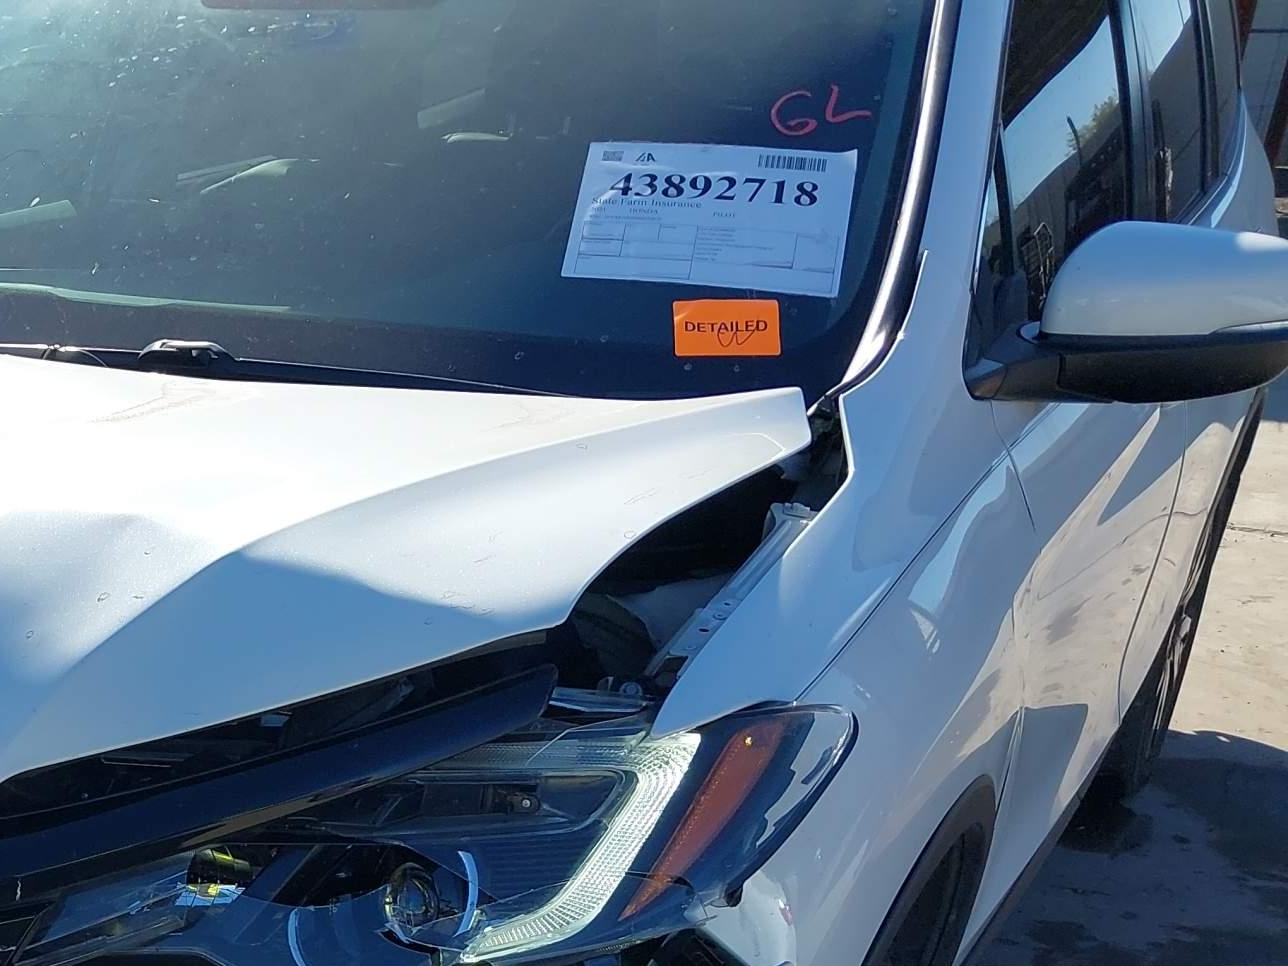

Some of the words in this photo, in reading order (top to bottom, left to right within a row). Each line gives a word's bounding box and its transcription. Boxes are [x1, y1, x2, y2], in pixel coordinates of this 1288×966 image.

[608, 172, 819, 207] 43892718
[620, 198, 648, 207] Farm
[651, 199, 703, 209] Insurance
[684, 319, 769, 334] DETAILED
